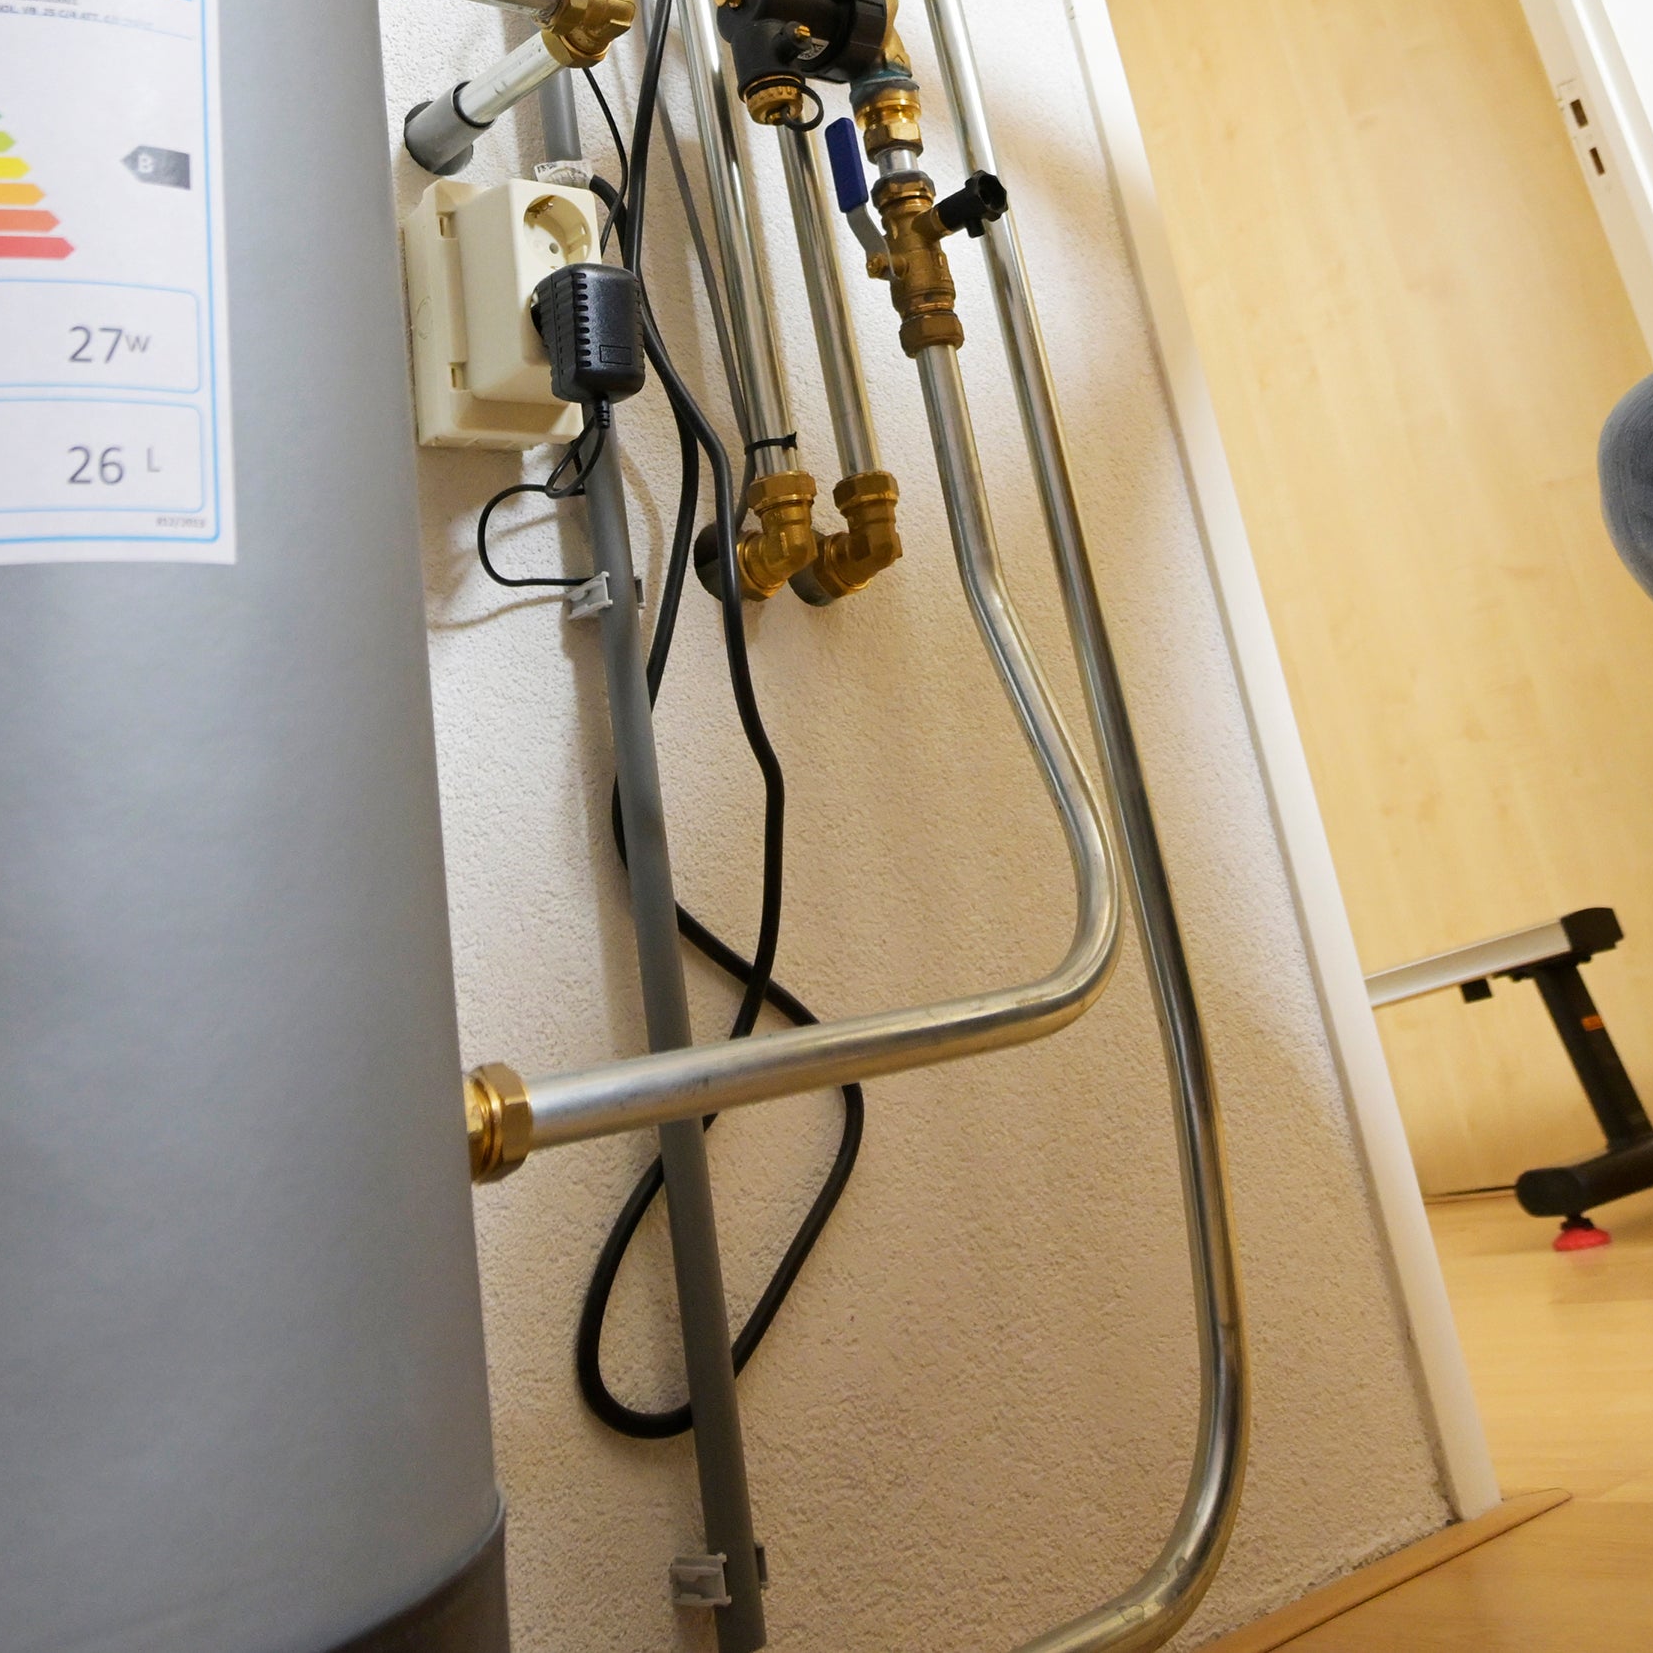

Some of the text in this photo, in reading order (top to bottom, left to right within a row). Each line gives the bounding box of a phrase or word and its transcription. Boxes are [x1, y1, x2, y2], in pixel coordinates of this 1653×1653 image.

[137, 154, 155, 175] B
[67, 445, 162, 486] 26 L
